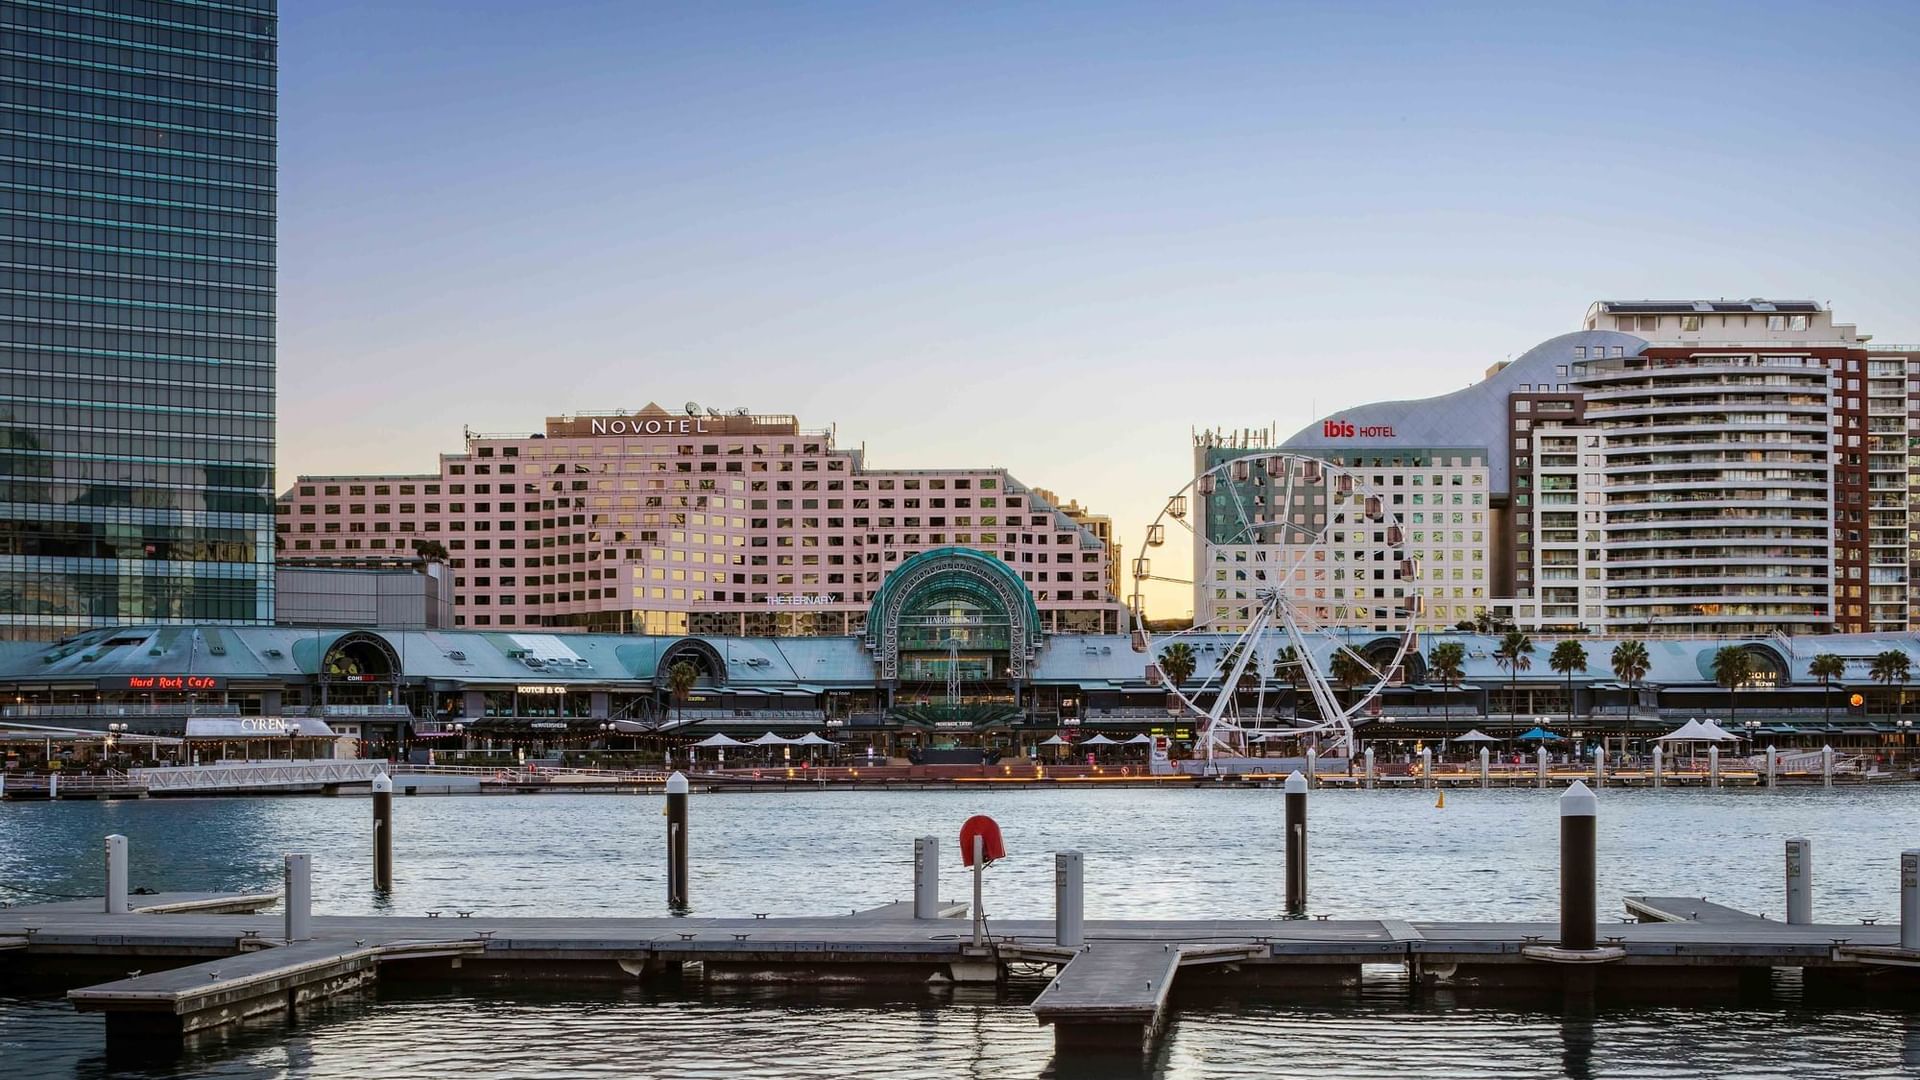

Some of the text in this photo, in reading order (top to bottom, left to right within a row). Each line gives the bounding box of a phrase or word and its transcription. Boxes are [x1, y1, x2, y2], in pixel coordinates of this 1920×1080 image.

[592, 418, 708, 434] NOVOTEL
[1324, 420, 1396, 437] ibis HOTEL
[765, 596, 784, 605] THE
[130, 677, 215, 689] Hard Rock Cafe
[241, 718, 285, 730] CYREN
